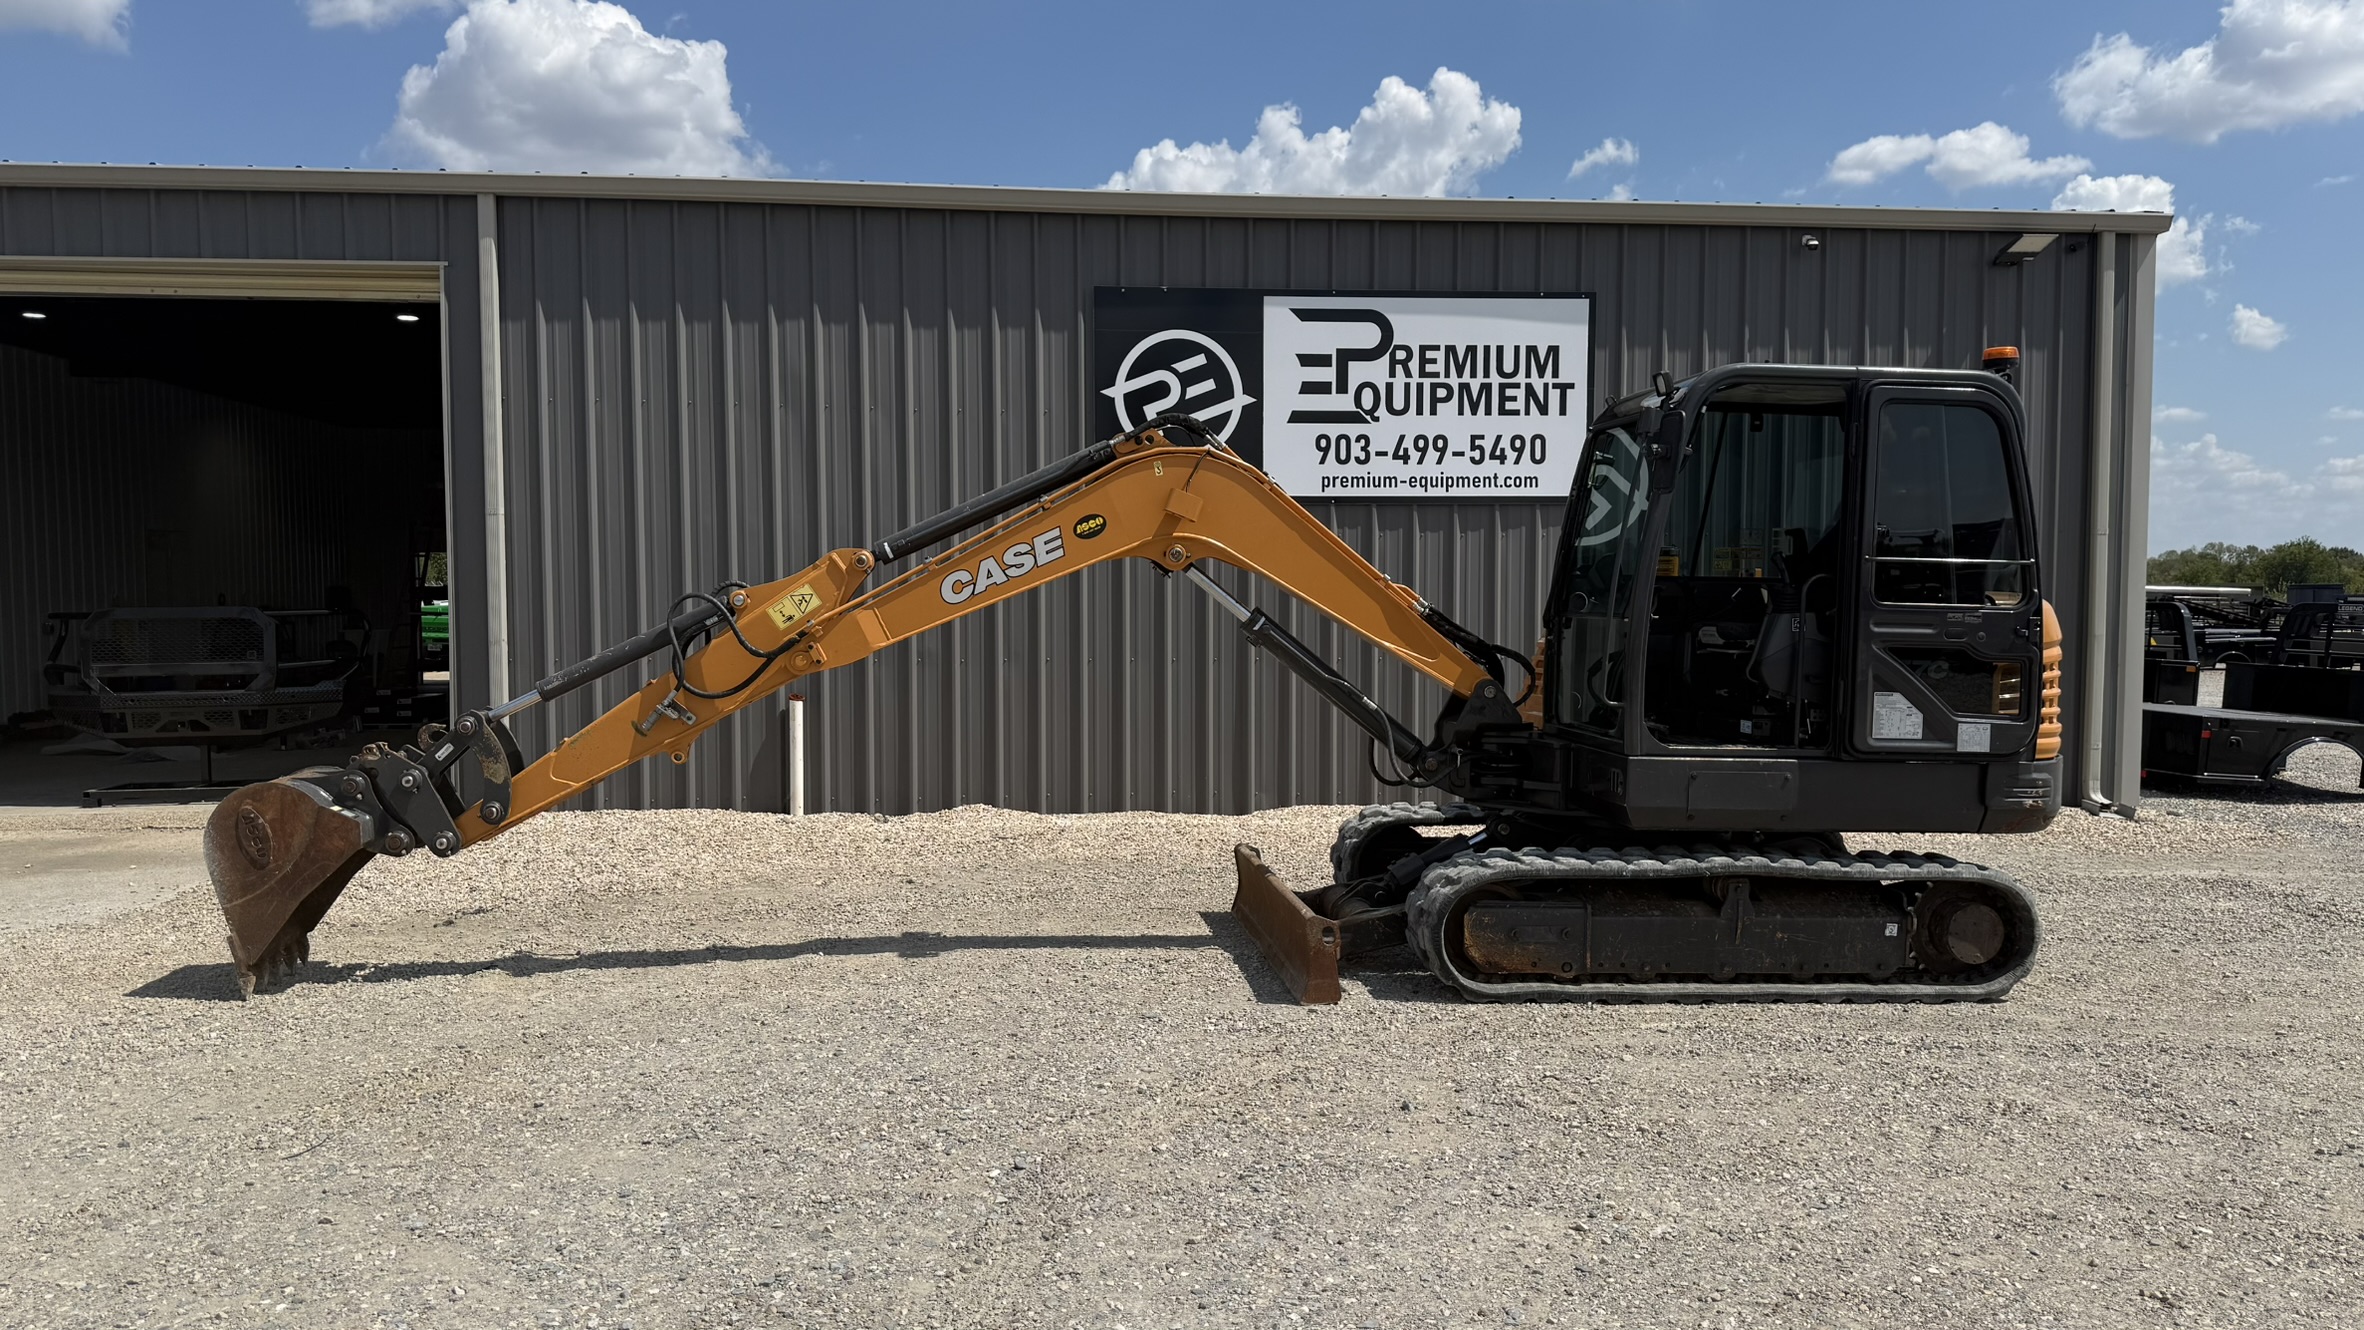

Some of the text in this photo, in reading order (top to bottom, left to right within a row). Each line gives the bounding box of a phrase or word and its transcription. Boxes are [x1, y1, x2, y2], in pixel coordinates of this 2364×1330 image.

[1288, 308, 1560, 394] PREMIUM
[1286, 353, 1575, 424] EQUIPMENT
[1314, 433, 1547, 466] 903-499-5490
[1321, 471, 1539, 493] premium-equipment.com
[940, 525, 1065, 605] CASE
